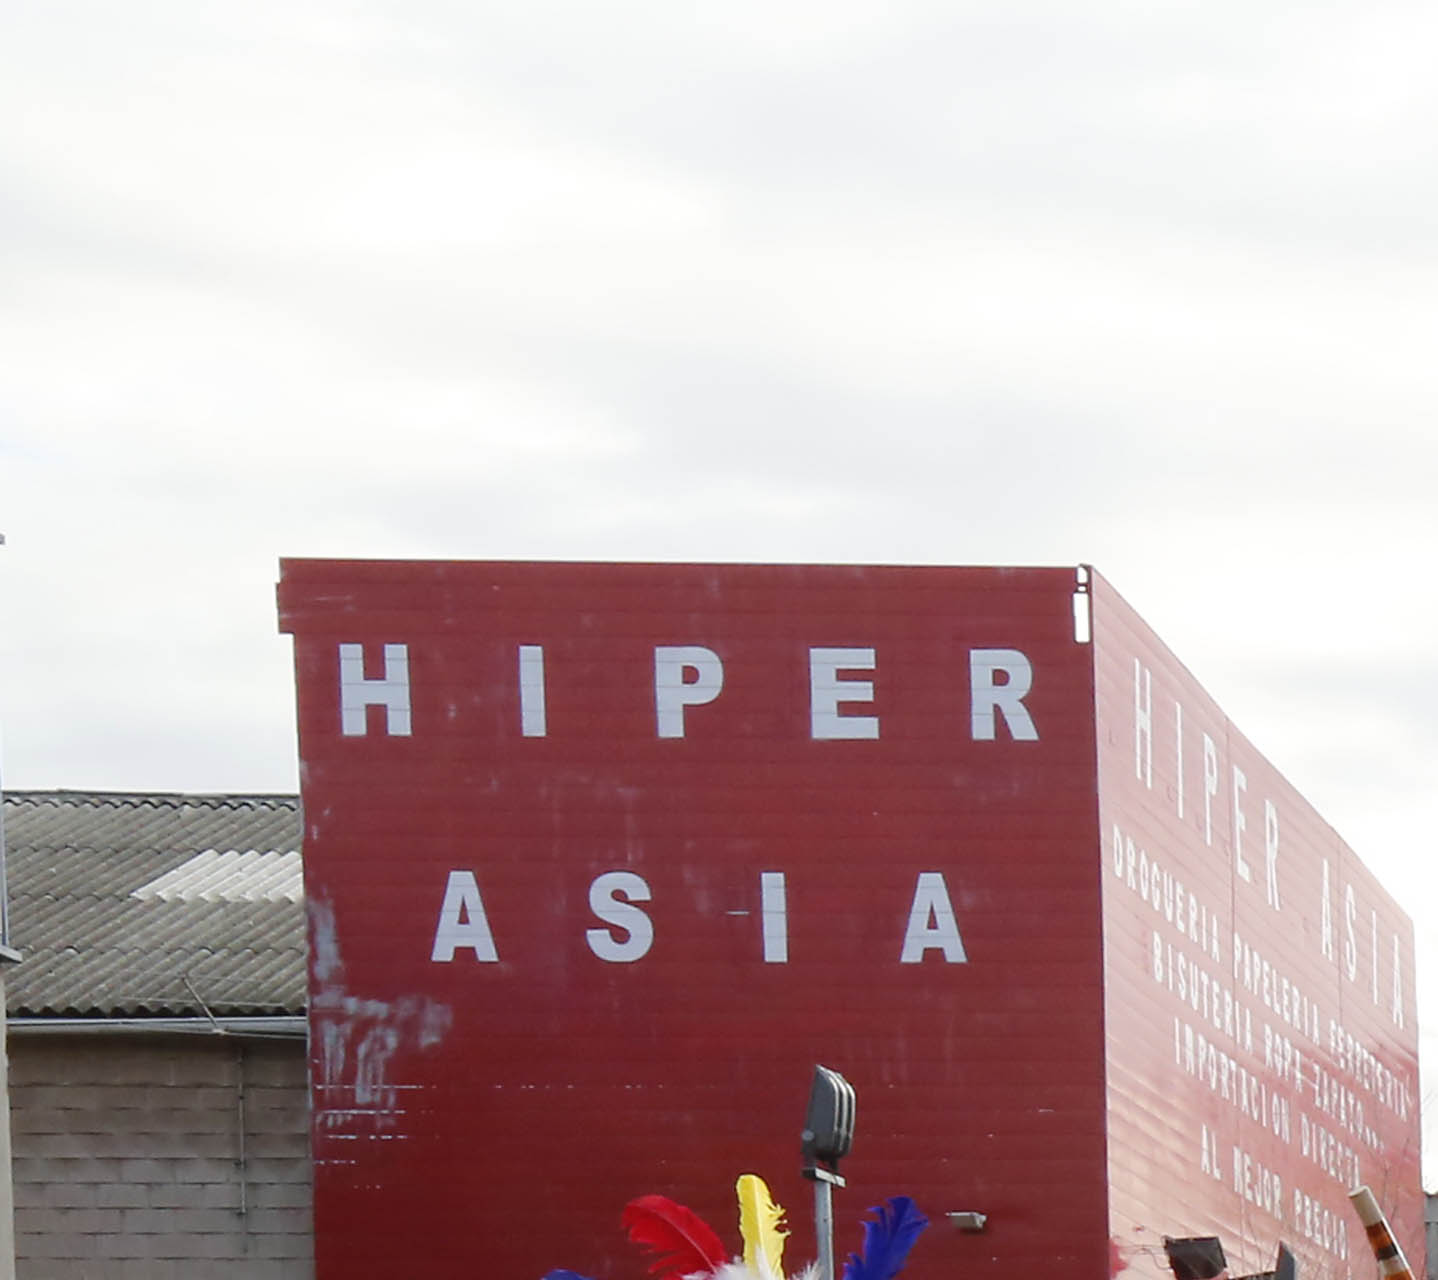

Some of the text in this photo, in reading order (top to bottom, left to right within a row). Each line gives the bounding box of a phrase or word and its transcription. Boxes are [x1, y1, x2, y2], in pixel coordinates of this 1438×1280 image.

[338, 643, 1041, 742] HIPER
[1134, 658, 1403, 1030] HIPER ASIA
[431, 869, 967, 964] ASIA
